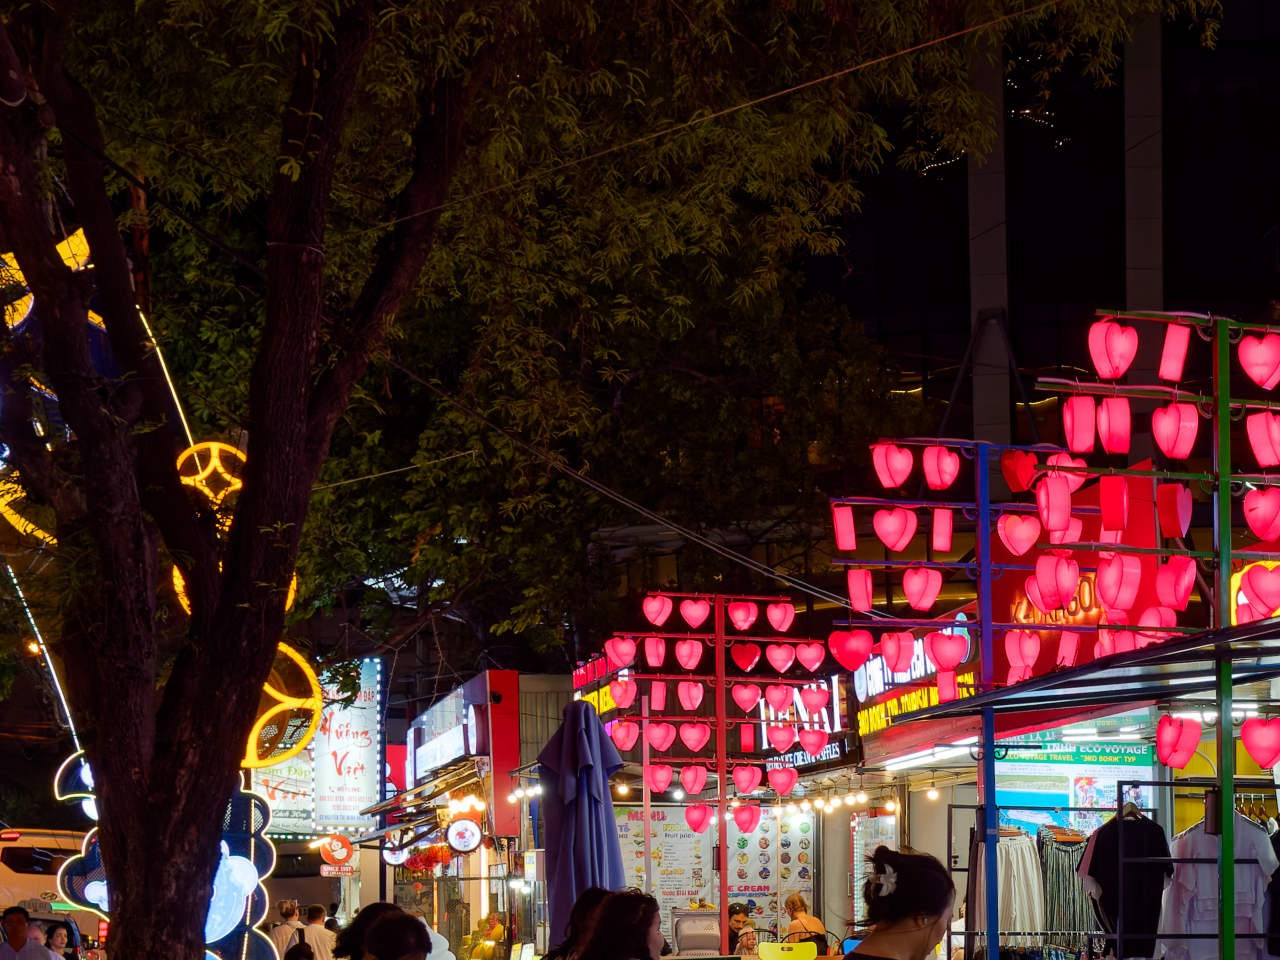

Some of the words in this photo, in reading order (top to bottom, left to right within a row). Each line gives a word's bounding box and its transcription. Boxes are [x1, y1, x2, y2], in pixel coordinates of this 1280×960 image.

[1080, 743, 1102, 754] ECO
[1105, 744, 1148, 756] VOYAGE
[738, 885, 770, 893] CREAM
